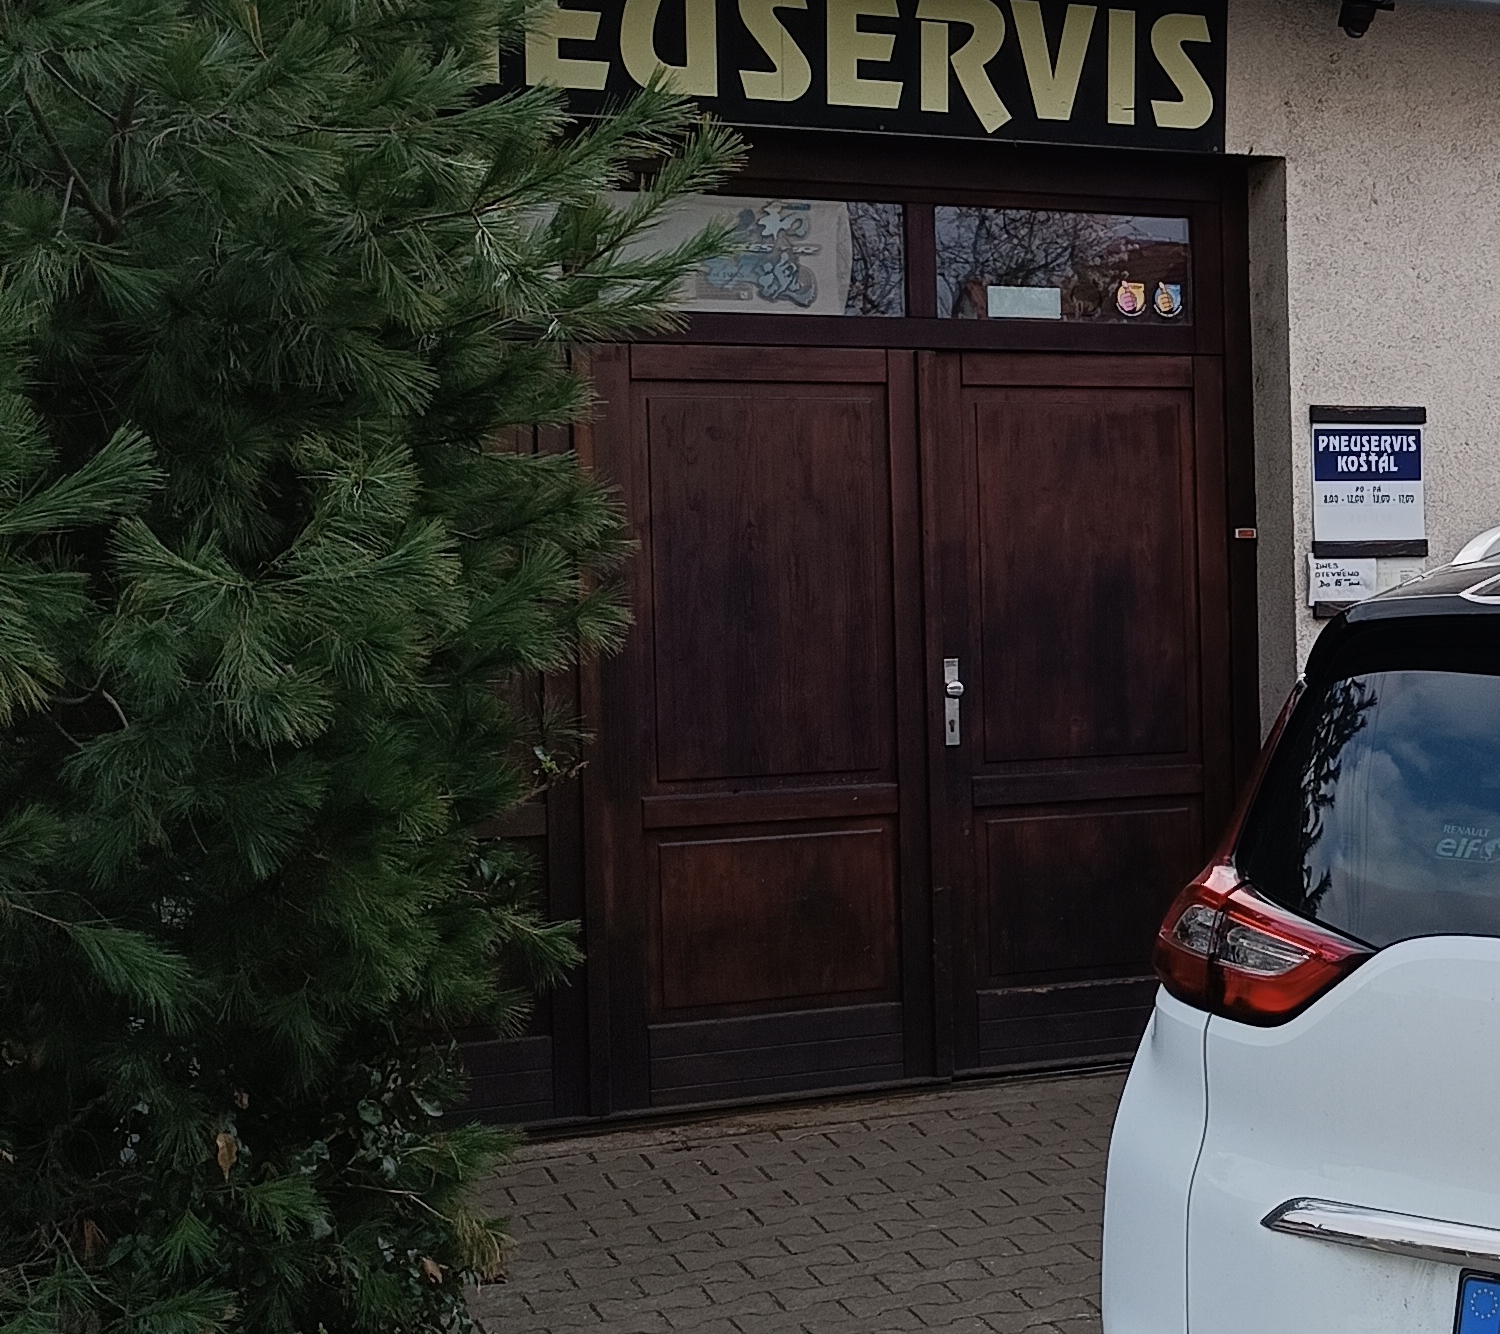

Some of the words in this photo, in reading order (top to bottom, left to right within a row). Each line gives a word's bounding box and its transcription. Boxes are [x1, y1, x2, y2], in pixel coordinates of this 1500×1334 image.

[1318, 435, 1417, 454] PNEUSERVIS
[1337, 451, 1399, 474] KOŠŤÁL
[1355, 485, 1365, 493] PO
[1315, 562, 1339, 570] DNES
[1442, 824, 1491, 838] RENAULT
[1436, 837, 1482, 859] elf
